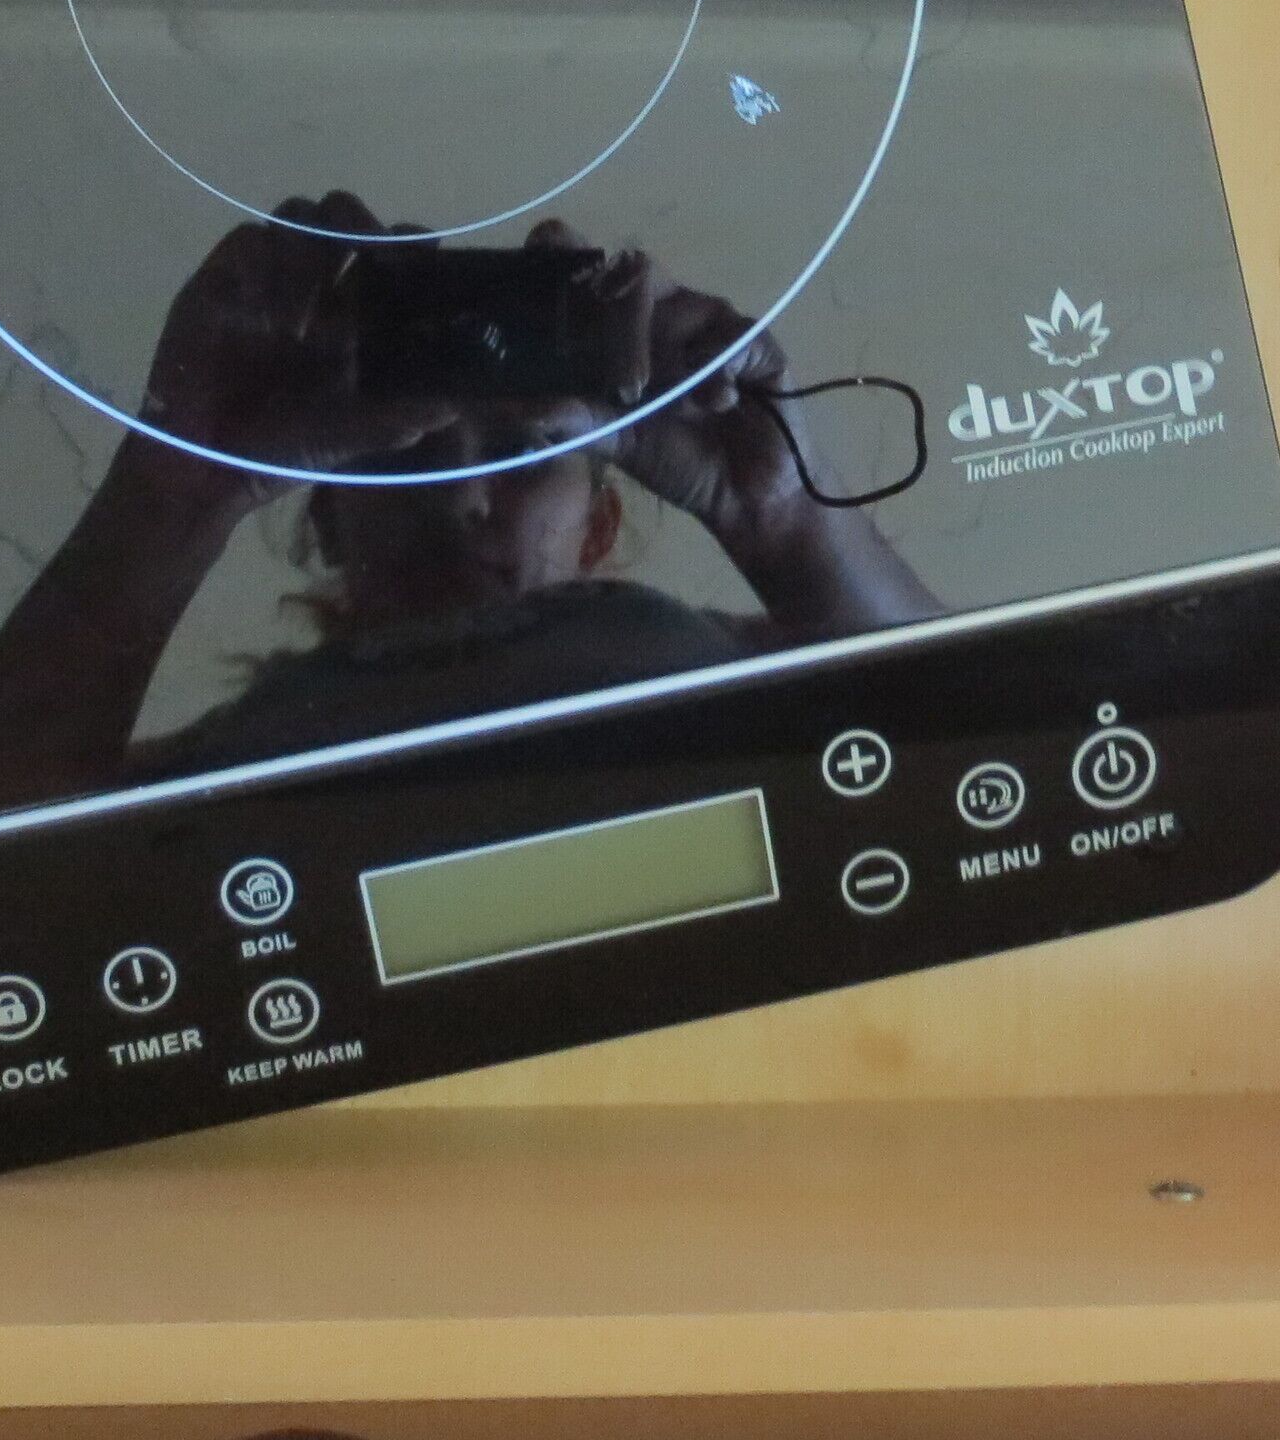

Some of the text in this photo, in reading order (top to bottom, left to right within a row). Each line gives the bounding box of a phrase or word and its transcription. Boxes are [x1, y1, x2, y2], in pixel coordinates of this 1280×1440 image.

[966, 411, 1226, 483] Induction Cooktop Expert
[1070, 812, 1176, 858] ON/OFF
[959, 843, 1042, 883] MENU
[240, 933, 297, 960] BOIL
[108, 1028, 204, 1066] TIMER
[227, 1040, 363, 1087] KEEP WARM
